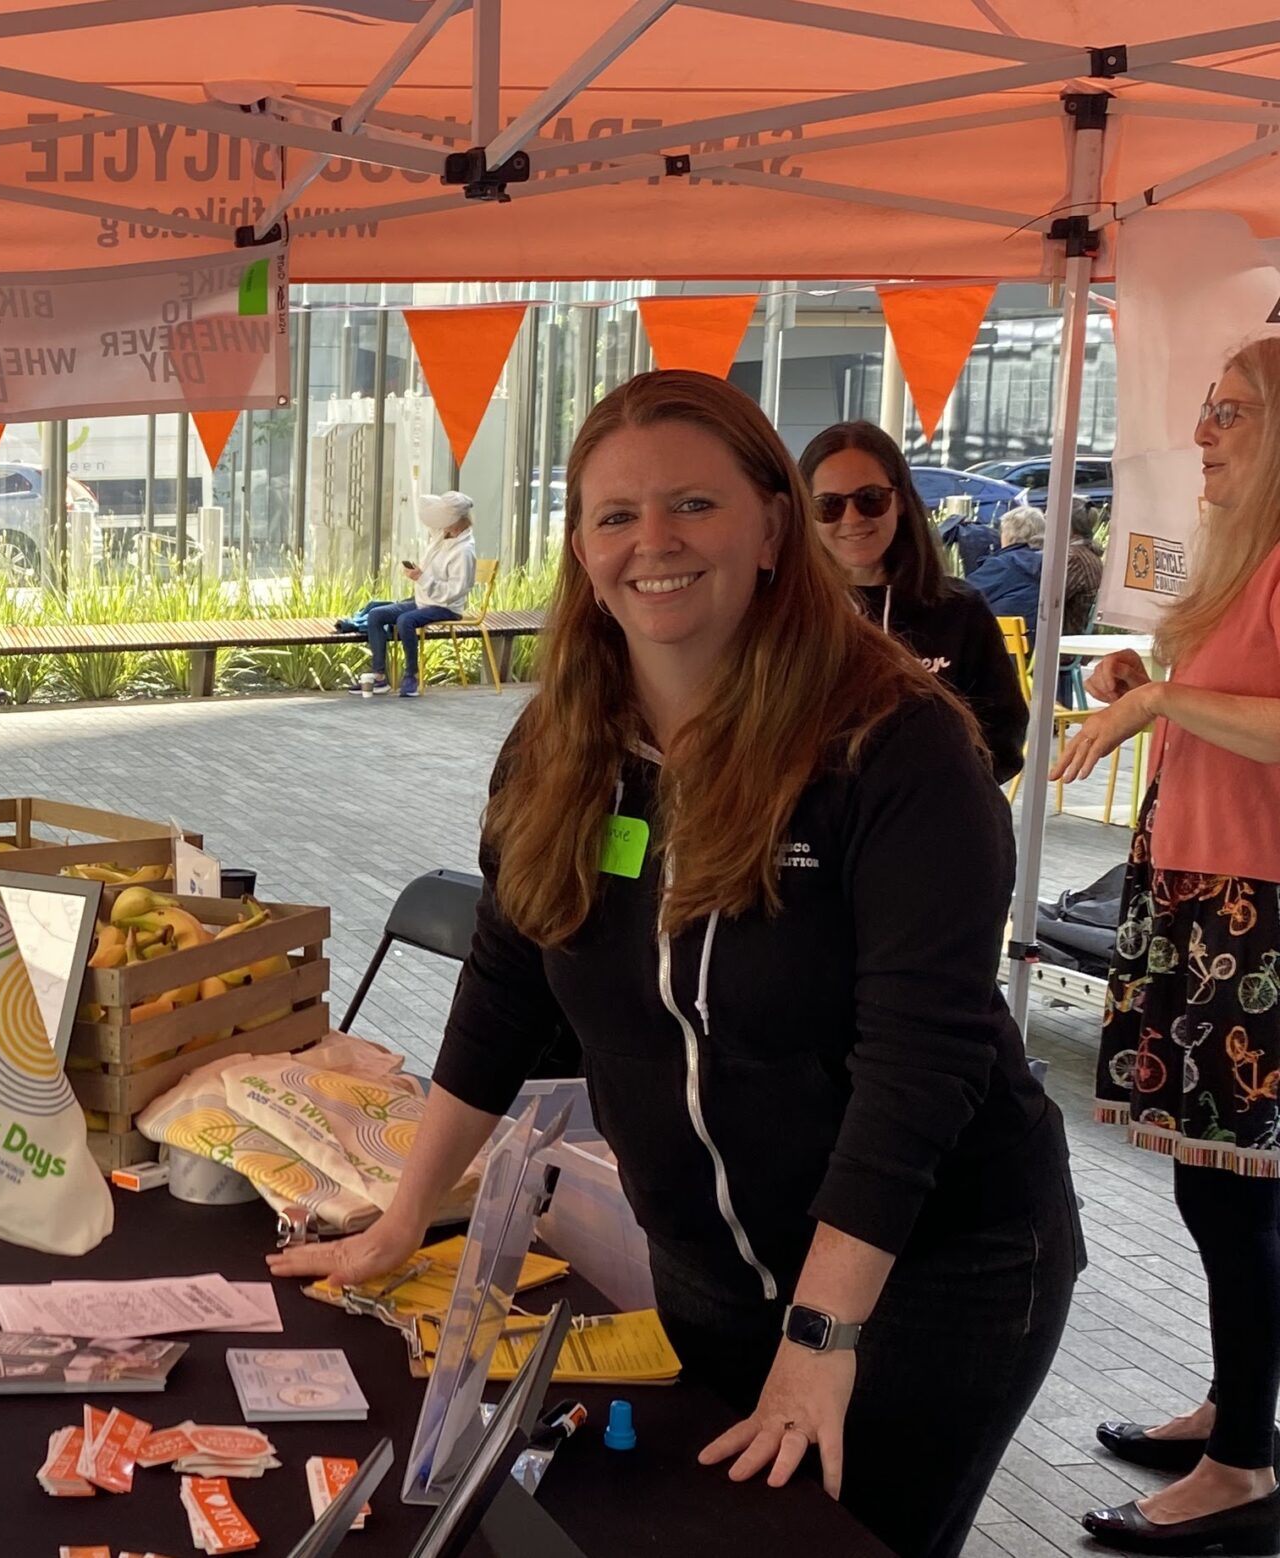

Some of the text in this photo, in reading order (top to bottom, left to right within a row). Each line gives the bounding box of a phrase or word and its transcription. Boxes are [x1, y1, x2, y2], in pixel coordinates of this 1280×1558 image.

[240, 1076, 277, 1095] Bike
[278, 1091, 298, 1107] To
[2, 1122, 67, 1178] Days
[211, 1508, 242, 1526] MY
